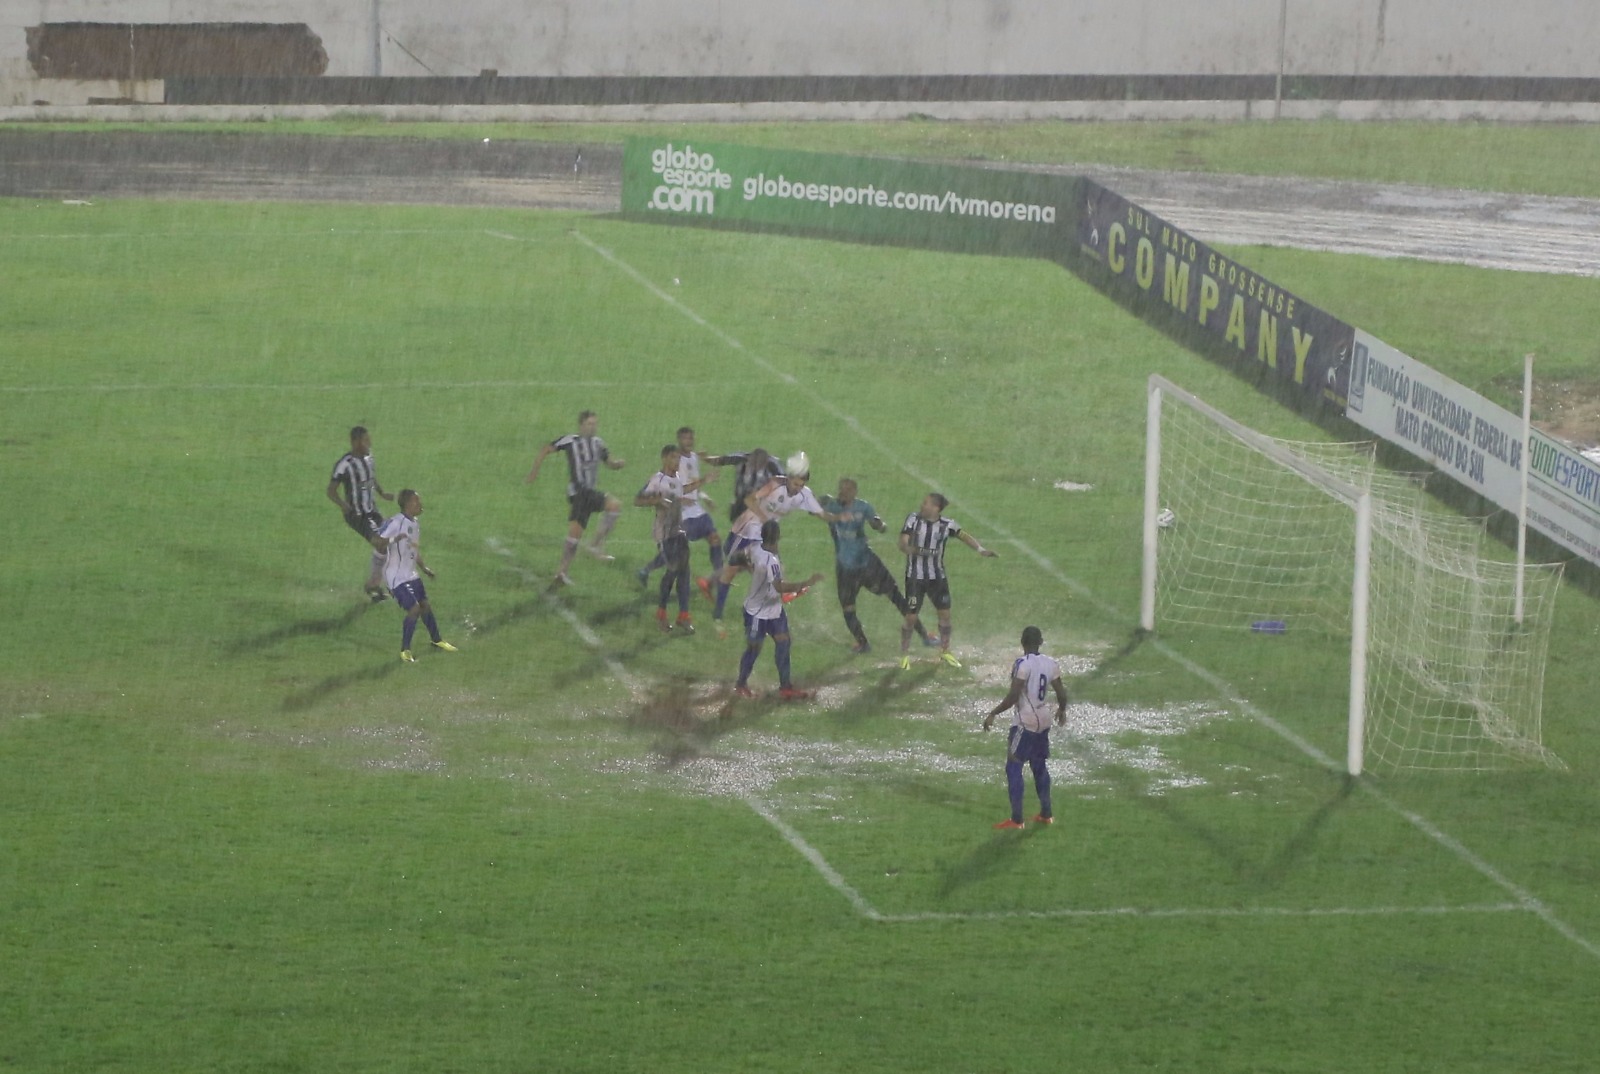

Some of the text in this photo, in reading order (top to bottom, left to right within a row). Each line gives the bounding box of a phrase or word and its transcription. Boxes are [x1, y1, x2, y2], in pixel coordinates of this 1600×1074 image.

[652, 144, 713, 173] globo
[663, 167, 732, 190] esporte
[647, 184, 714, 214] .com
[743, 174, 1056, 223] globoesporte.com/tvmorena
[1127, 207, 1296, 319] SUL MATO GROSSENSE
[1107, 222, 1314, 385] COMPANY
[1394, 405, 1485, 485] MATO GROSSO DO SUL
[1411, 379, 1473, 441] UNIVERSIDADE
[1473, 416, 1509, 465] FEDERAL
[1510, 438, 1522, 471] DE
[1528, 435, 1600, 506] FUNDESPORT
[1037, 673, 1048, 701] 8
